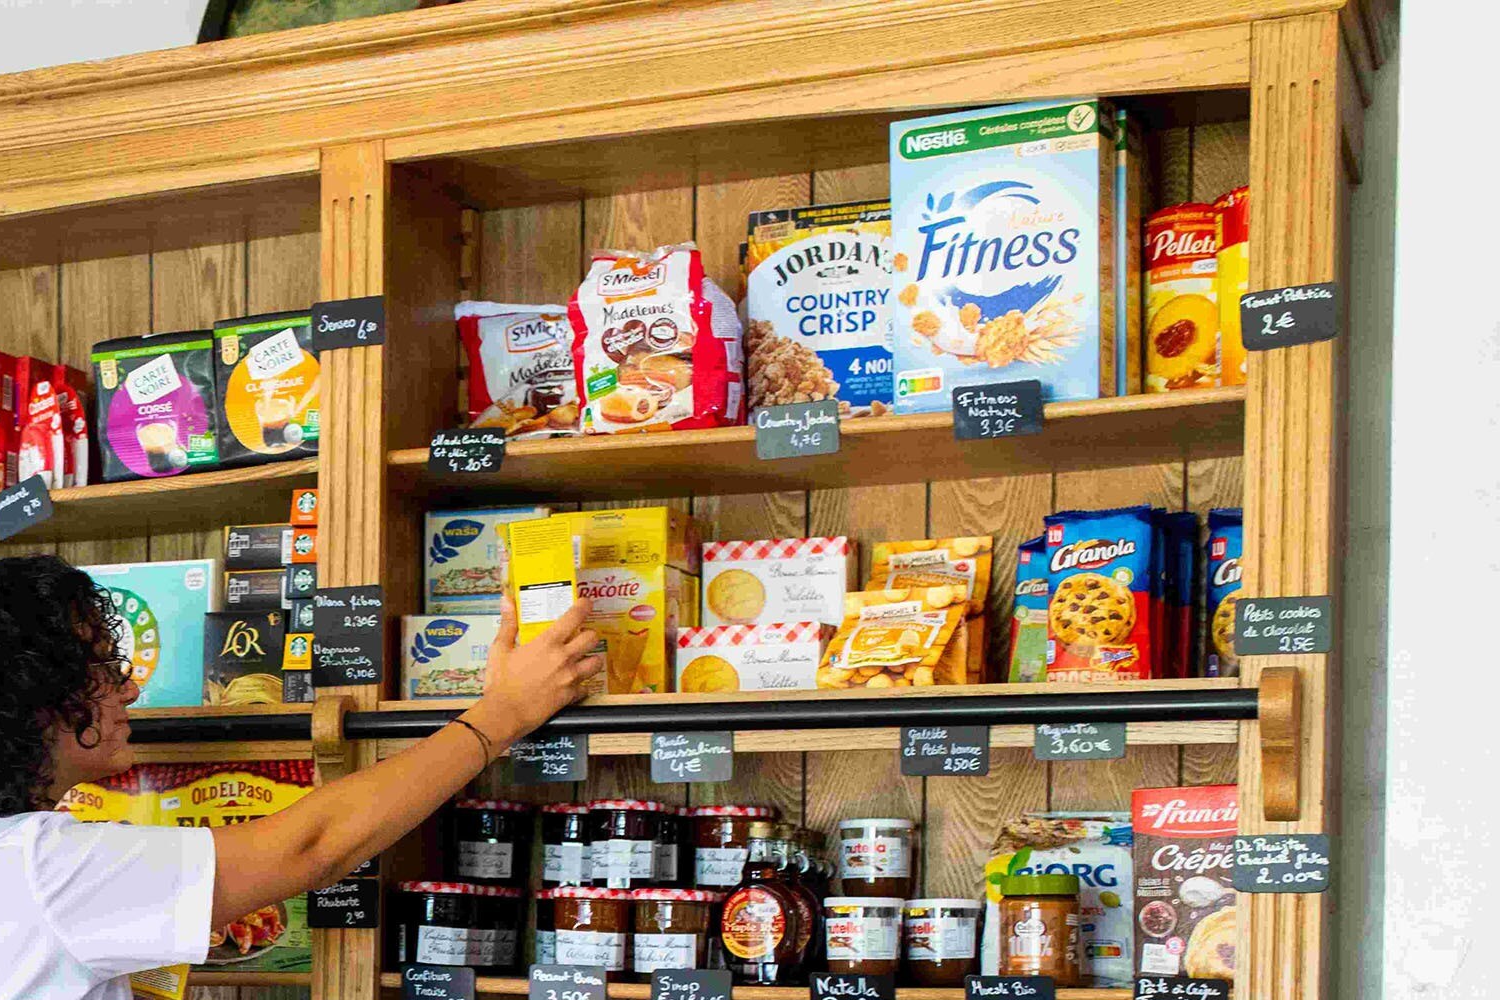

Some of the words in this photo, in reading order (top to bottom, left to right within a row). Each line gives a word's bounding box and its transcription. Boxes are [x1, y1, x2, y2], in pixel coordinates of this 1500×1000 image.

[916, 216, 1080, 281] Fitness
[787, 288, 890, 313] COUNTRY
[317, 315, 357, 333] Senseo
[1261, 311, 1296, 335] 2€
[252, 338, 291, 363] CARTE
[257, 349, 297, 373] NOIRE
[133, 364, 169, 389] CARTE
[849, 358, 862, 374] 4
[138, 376, 174, 397] NOIRE
[137, 401, 173, 416] CORSÉ
[443, 524, 479, 537] wasa
[1048, 528, 1062, 543] LU
[1050, 540, 1136, 573] Granola
[426, 626, 463, 638] wasa
[1243, 625, 1257, 638] de
[669, 759, 702, 777] 4€
[191, 784, 219, 806] OLD
[219, 780, 238, 797] EL
[406, 968, 452, 982] Confiture
[817, 976, 880, 998] Nutella
